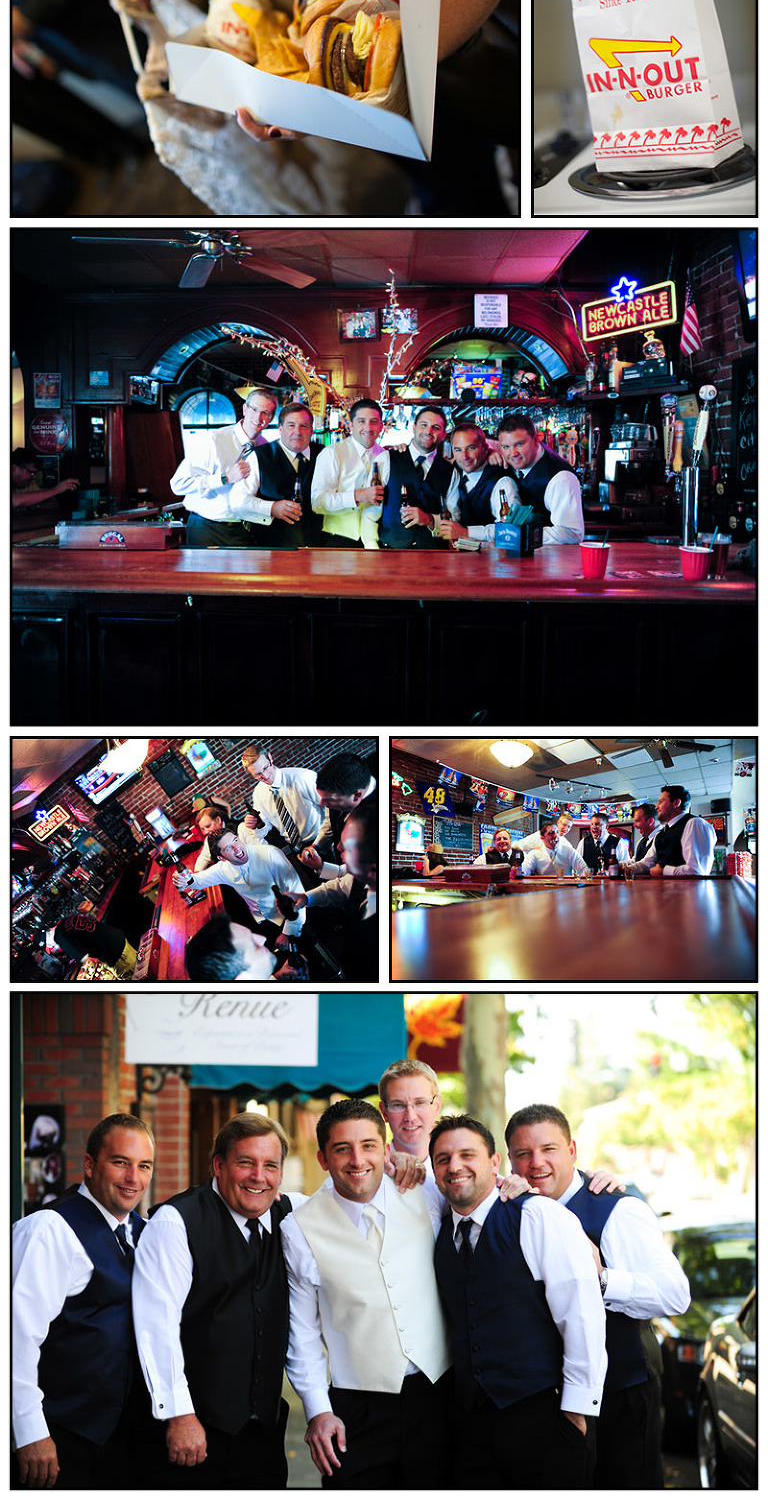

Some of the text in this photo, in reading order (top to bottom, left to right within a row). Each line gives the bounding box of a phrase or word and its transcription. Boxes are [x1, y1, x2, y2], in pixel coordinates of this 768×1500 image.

[586, 57, 700, 93] IN-N-OUT
[646, 81, 703, 100] BURGER
[588, 291, 669, 321] NEWCASTLE
[588, 305, 670, 333] BROWN ALE
[423, 786, 446, 804] 48
[178, 994, 290, 1019] Renue
